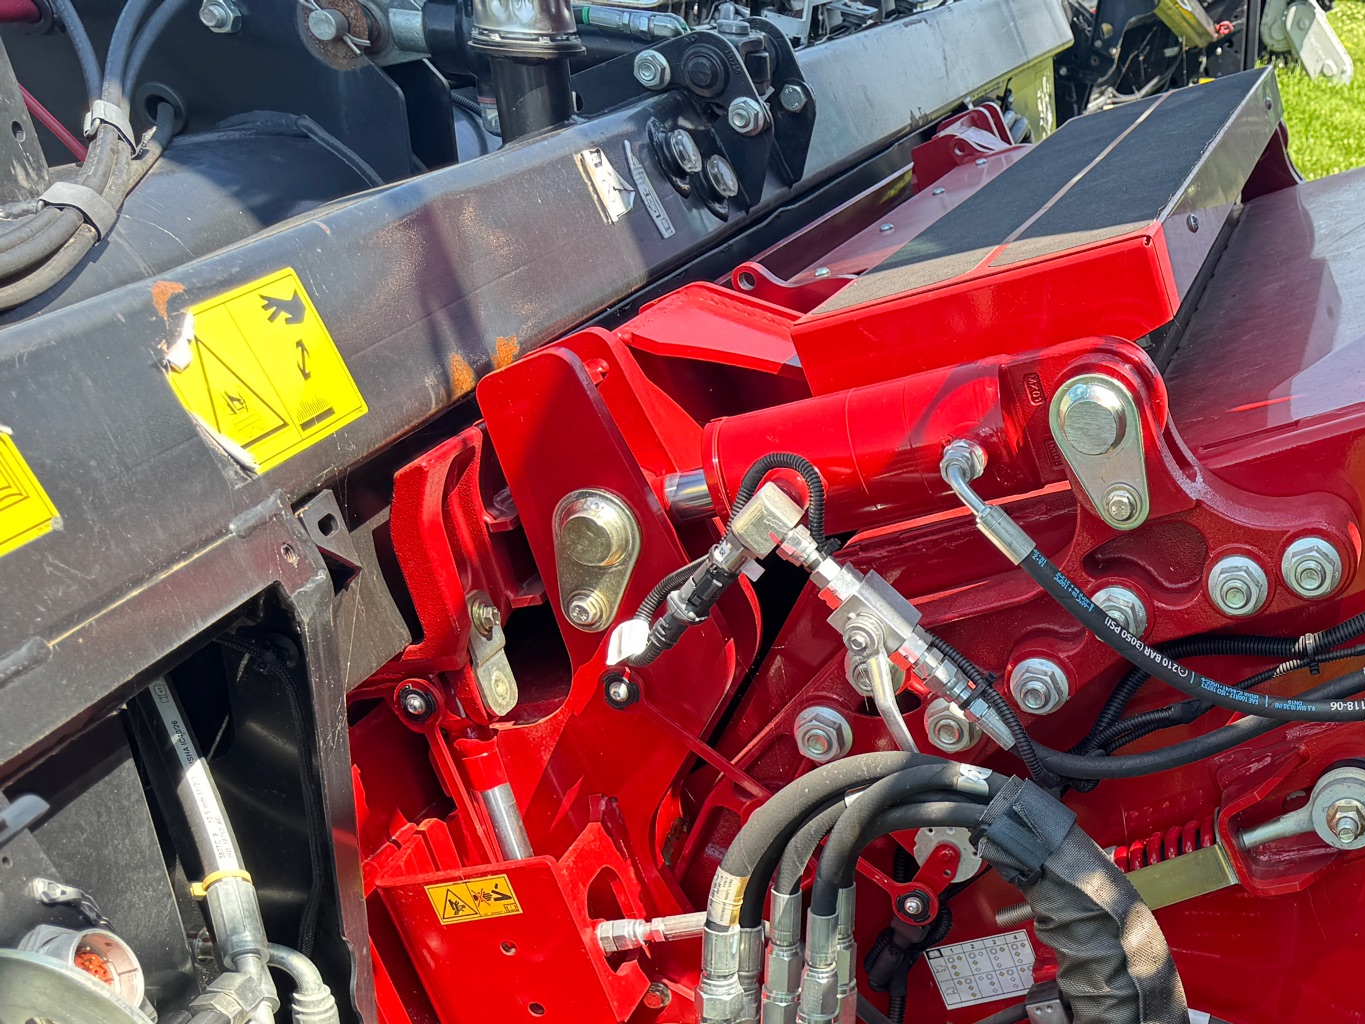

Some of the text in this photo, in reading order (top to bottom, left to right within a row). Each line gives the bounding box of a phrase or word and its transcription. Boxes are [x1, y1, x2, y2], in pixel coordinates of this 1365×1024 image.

[1103, 616, 1179, 672] 210 BAR (3050 PSI)
